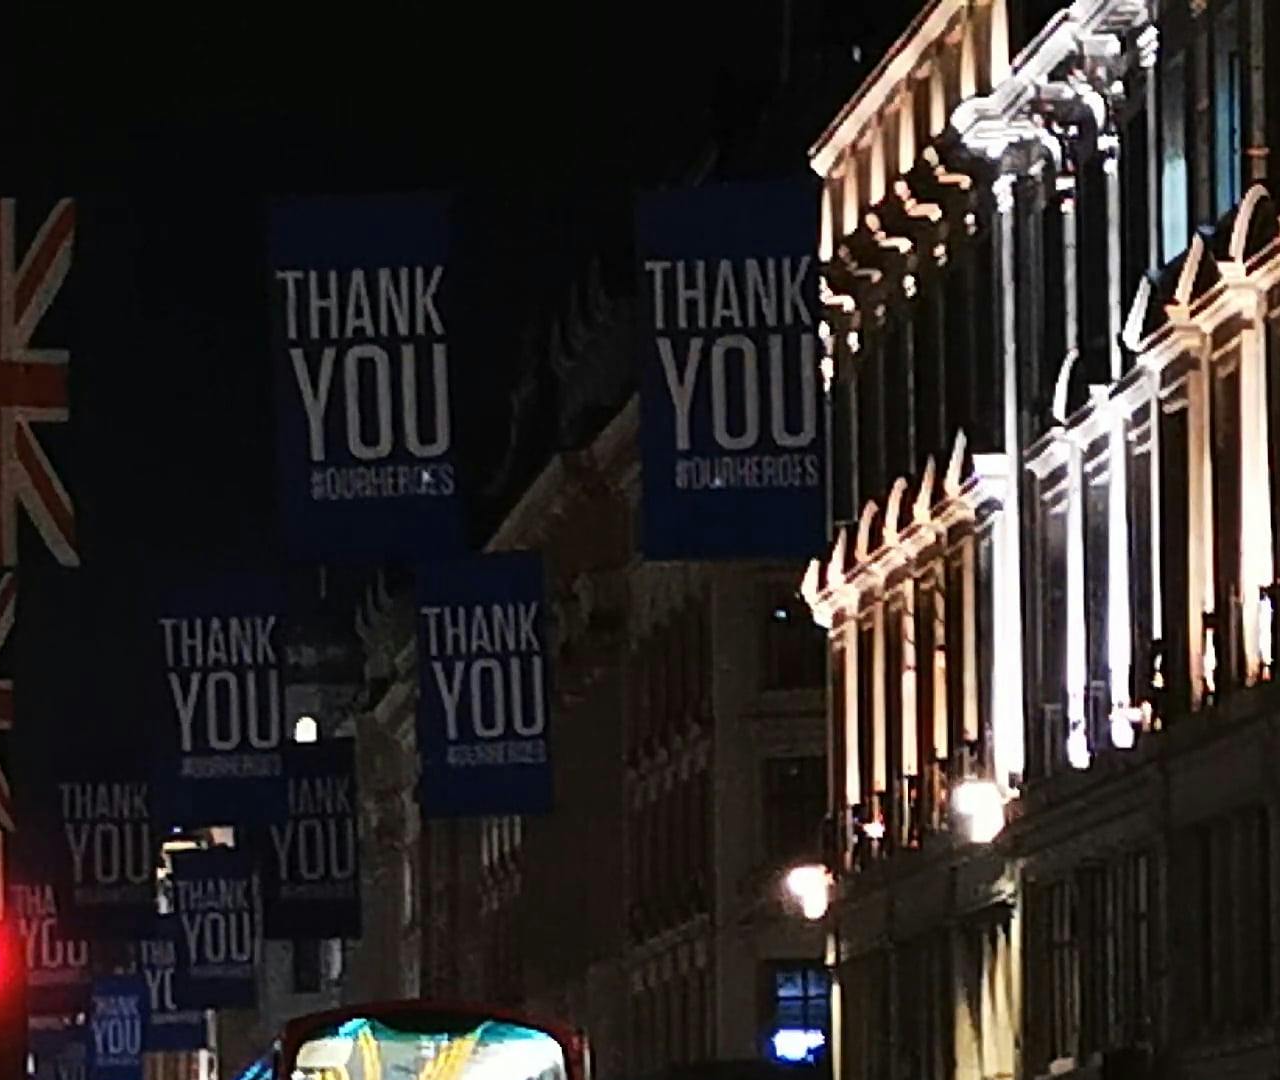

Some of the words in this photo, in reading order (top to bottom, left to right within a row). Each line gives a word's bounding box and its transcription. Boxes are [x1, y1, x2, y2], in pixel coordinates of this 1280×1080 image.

[276, 263, 447, 340] THANK
[645, 255, 814, 330] THANK
[289, 340, 452, 462] YOU
[656, 333, 817, 451] YOU
[158, 615, 278, 668] THANK
[420, 600, 542, 657] THANK
[167, 669, 282, 753] YOU
[433, 656, 548, 741] YOU
[58, 781, 149, 819] THANK
[64, 822, 151, 885] YOU
[271, 818, 355, 881] YOU
[176, 877, 250, 912] THANK
[181, 911, 252, 966] YOU
[92, 1016, 142, 1057] YOU
